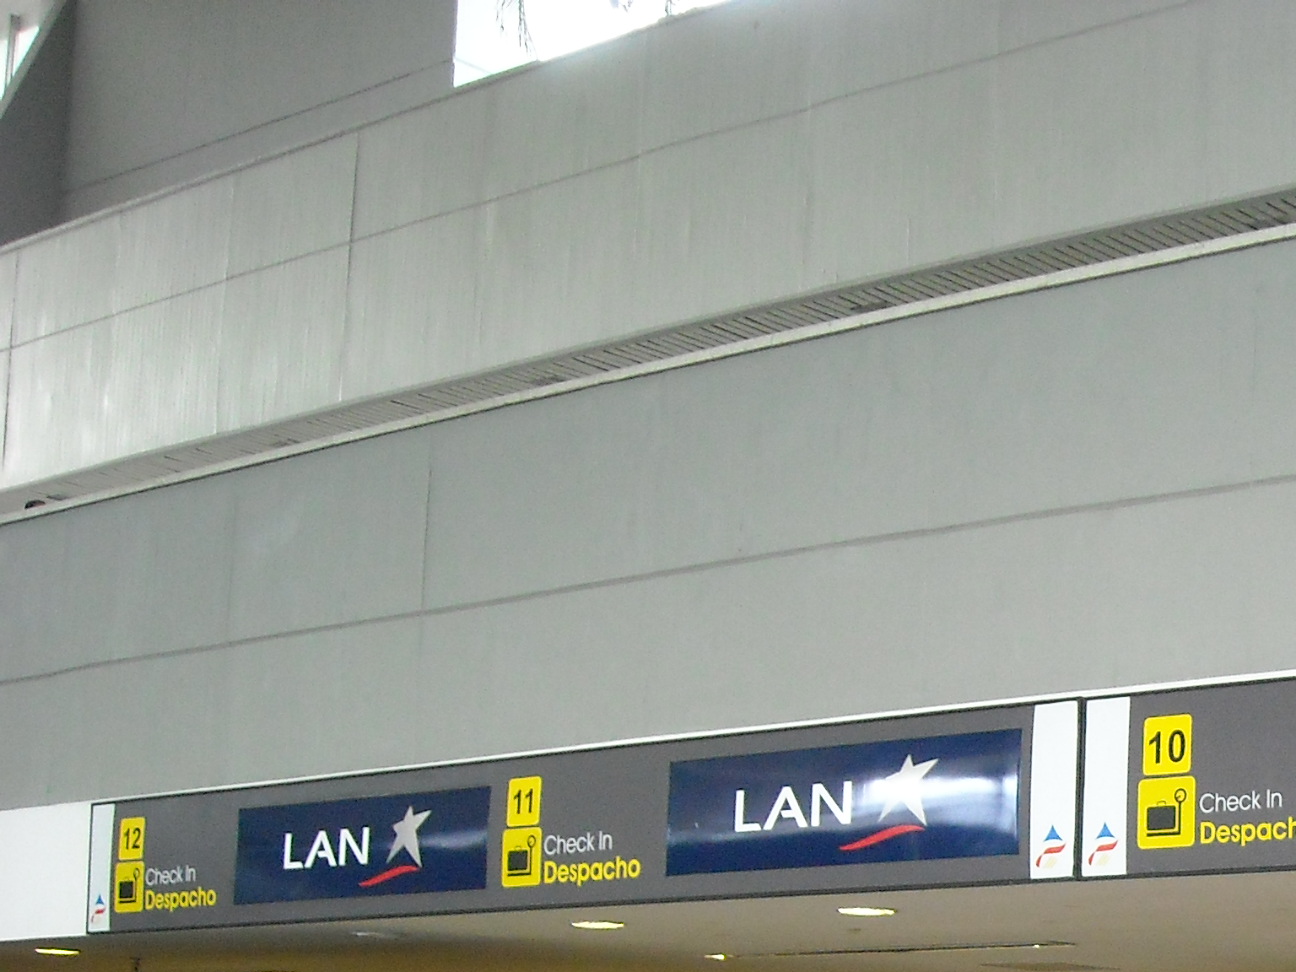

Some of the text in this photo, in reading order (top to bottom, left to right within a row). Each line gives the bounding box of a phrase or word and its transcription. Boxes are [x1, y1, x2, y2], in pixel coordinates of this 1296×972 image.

[1148, 730, 1186, 764] 10
[513, 789, 533, 814] 11
[734, 780, 853, 833] LAN
[1199, 789, 1282, 815] Check In
[124, 828, 141, 850] 12
[282, 826, 371, 870] LAN
[543, 831, 612, 855] Check In
[145, 865, 196, 886] Check In
[544, 855, 641, 886] Despacho
[145, 887, 217, 911] Despacho
